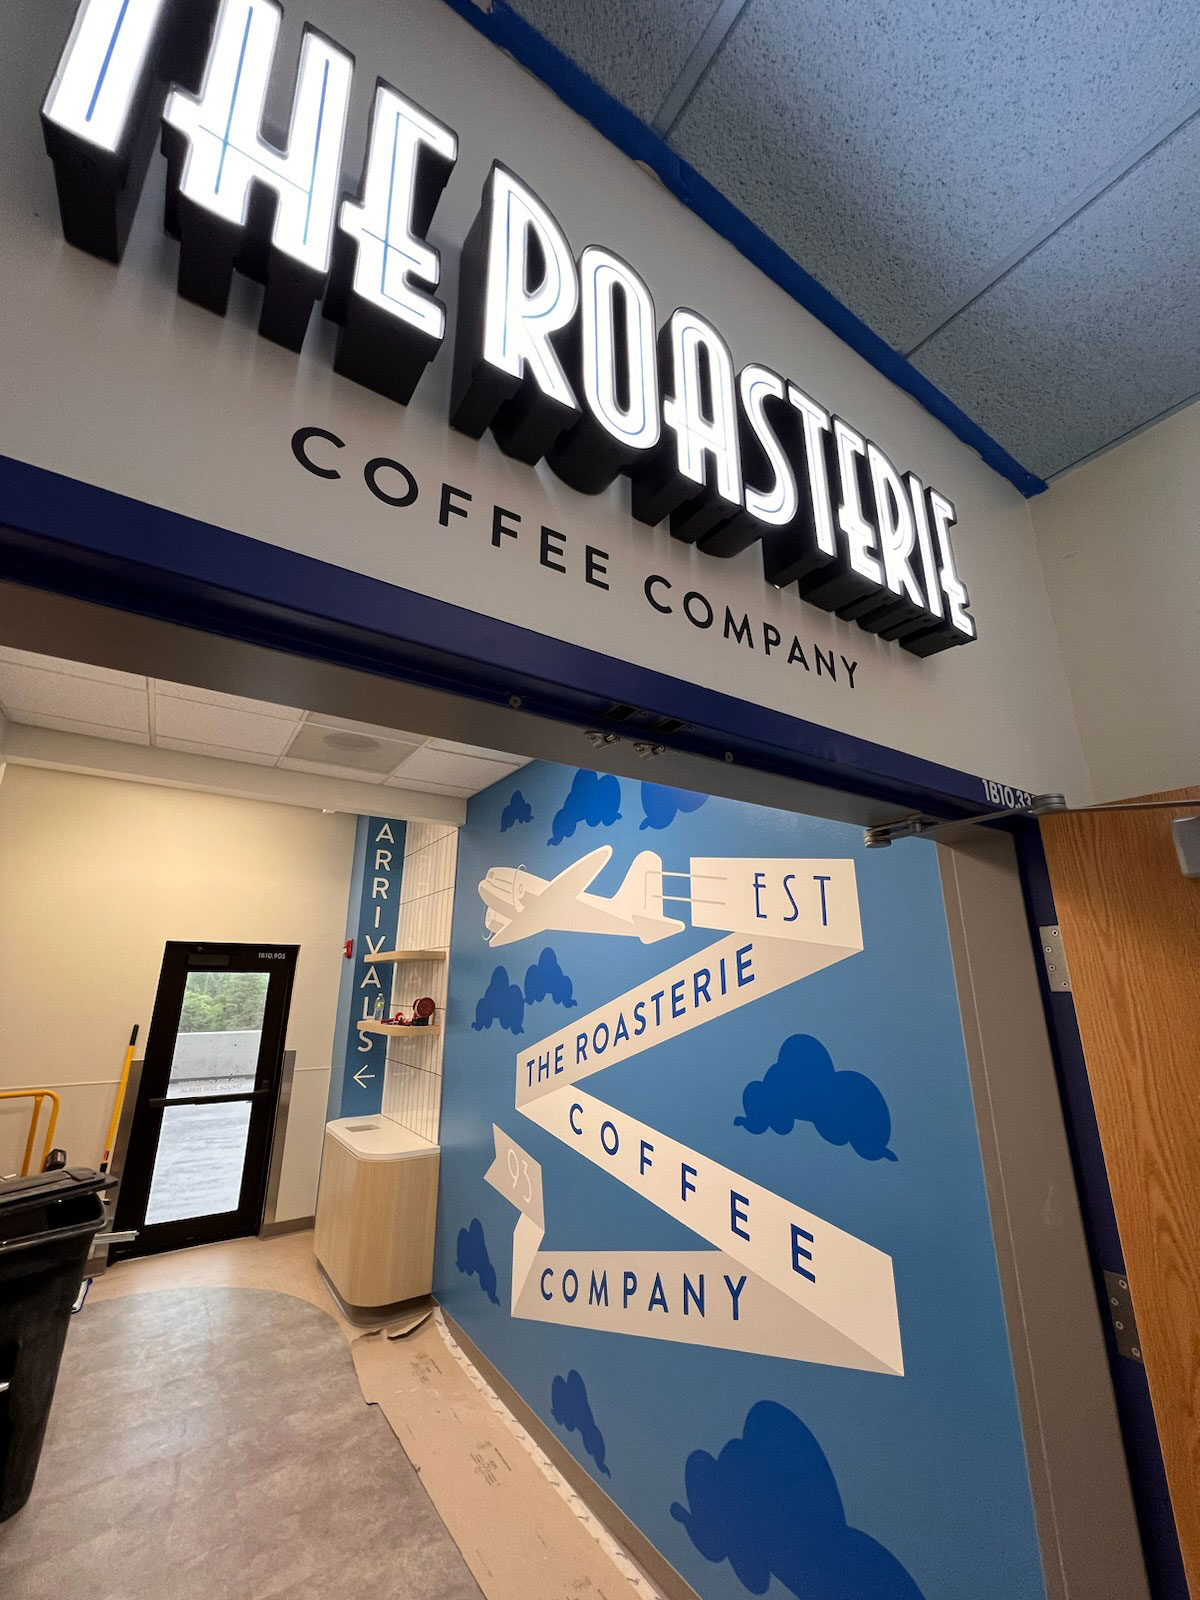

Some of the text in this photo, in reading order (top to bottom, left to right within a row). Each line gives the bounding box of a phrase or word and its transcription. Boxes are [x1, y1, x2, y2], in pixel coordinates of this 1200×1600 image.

[482, 164, 976, 640] ROASTERIE
[290, 425, 860, 690] COFFEE COMPANY
[357, 822, 394, 1053] ARRIVALS
[752, 871, 831, 926] EST
[526, 943, 756, 1087] THE ROASTERIE
[507, 1148, 532, 1203] 93
[569, 1103, 816, 1284] COFFEE
[539, 1267, 748, 1321] COMPANY
